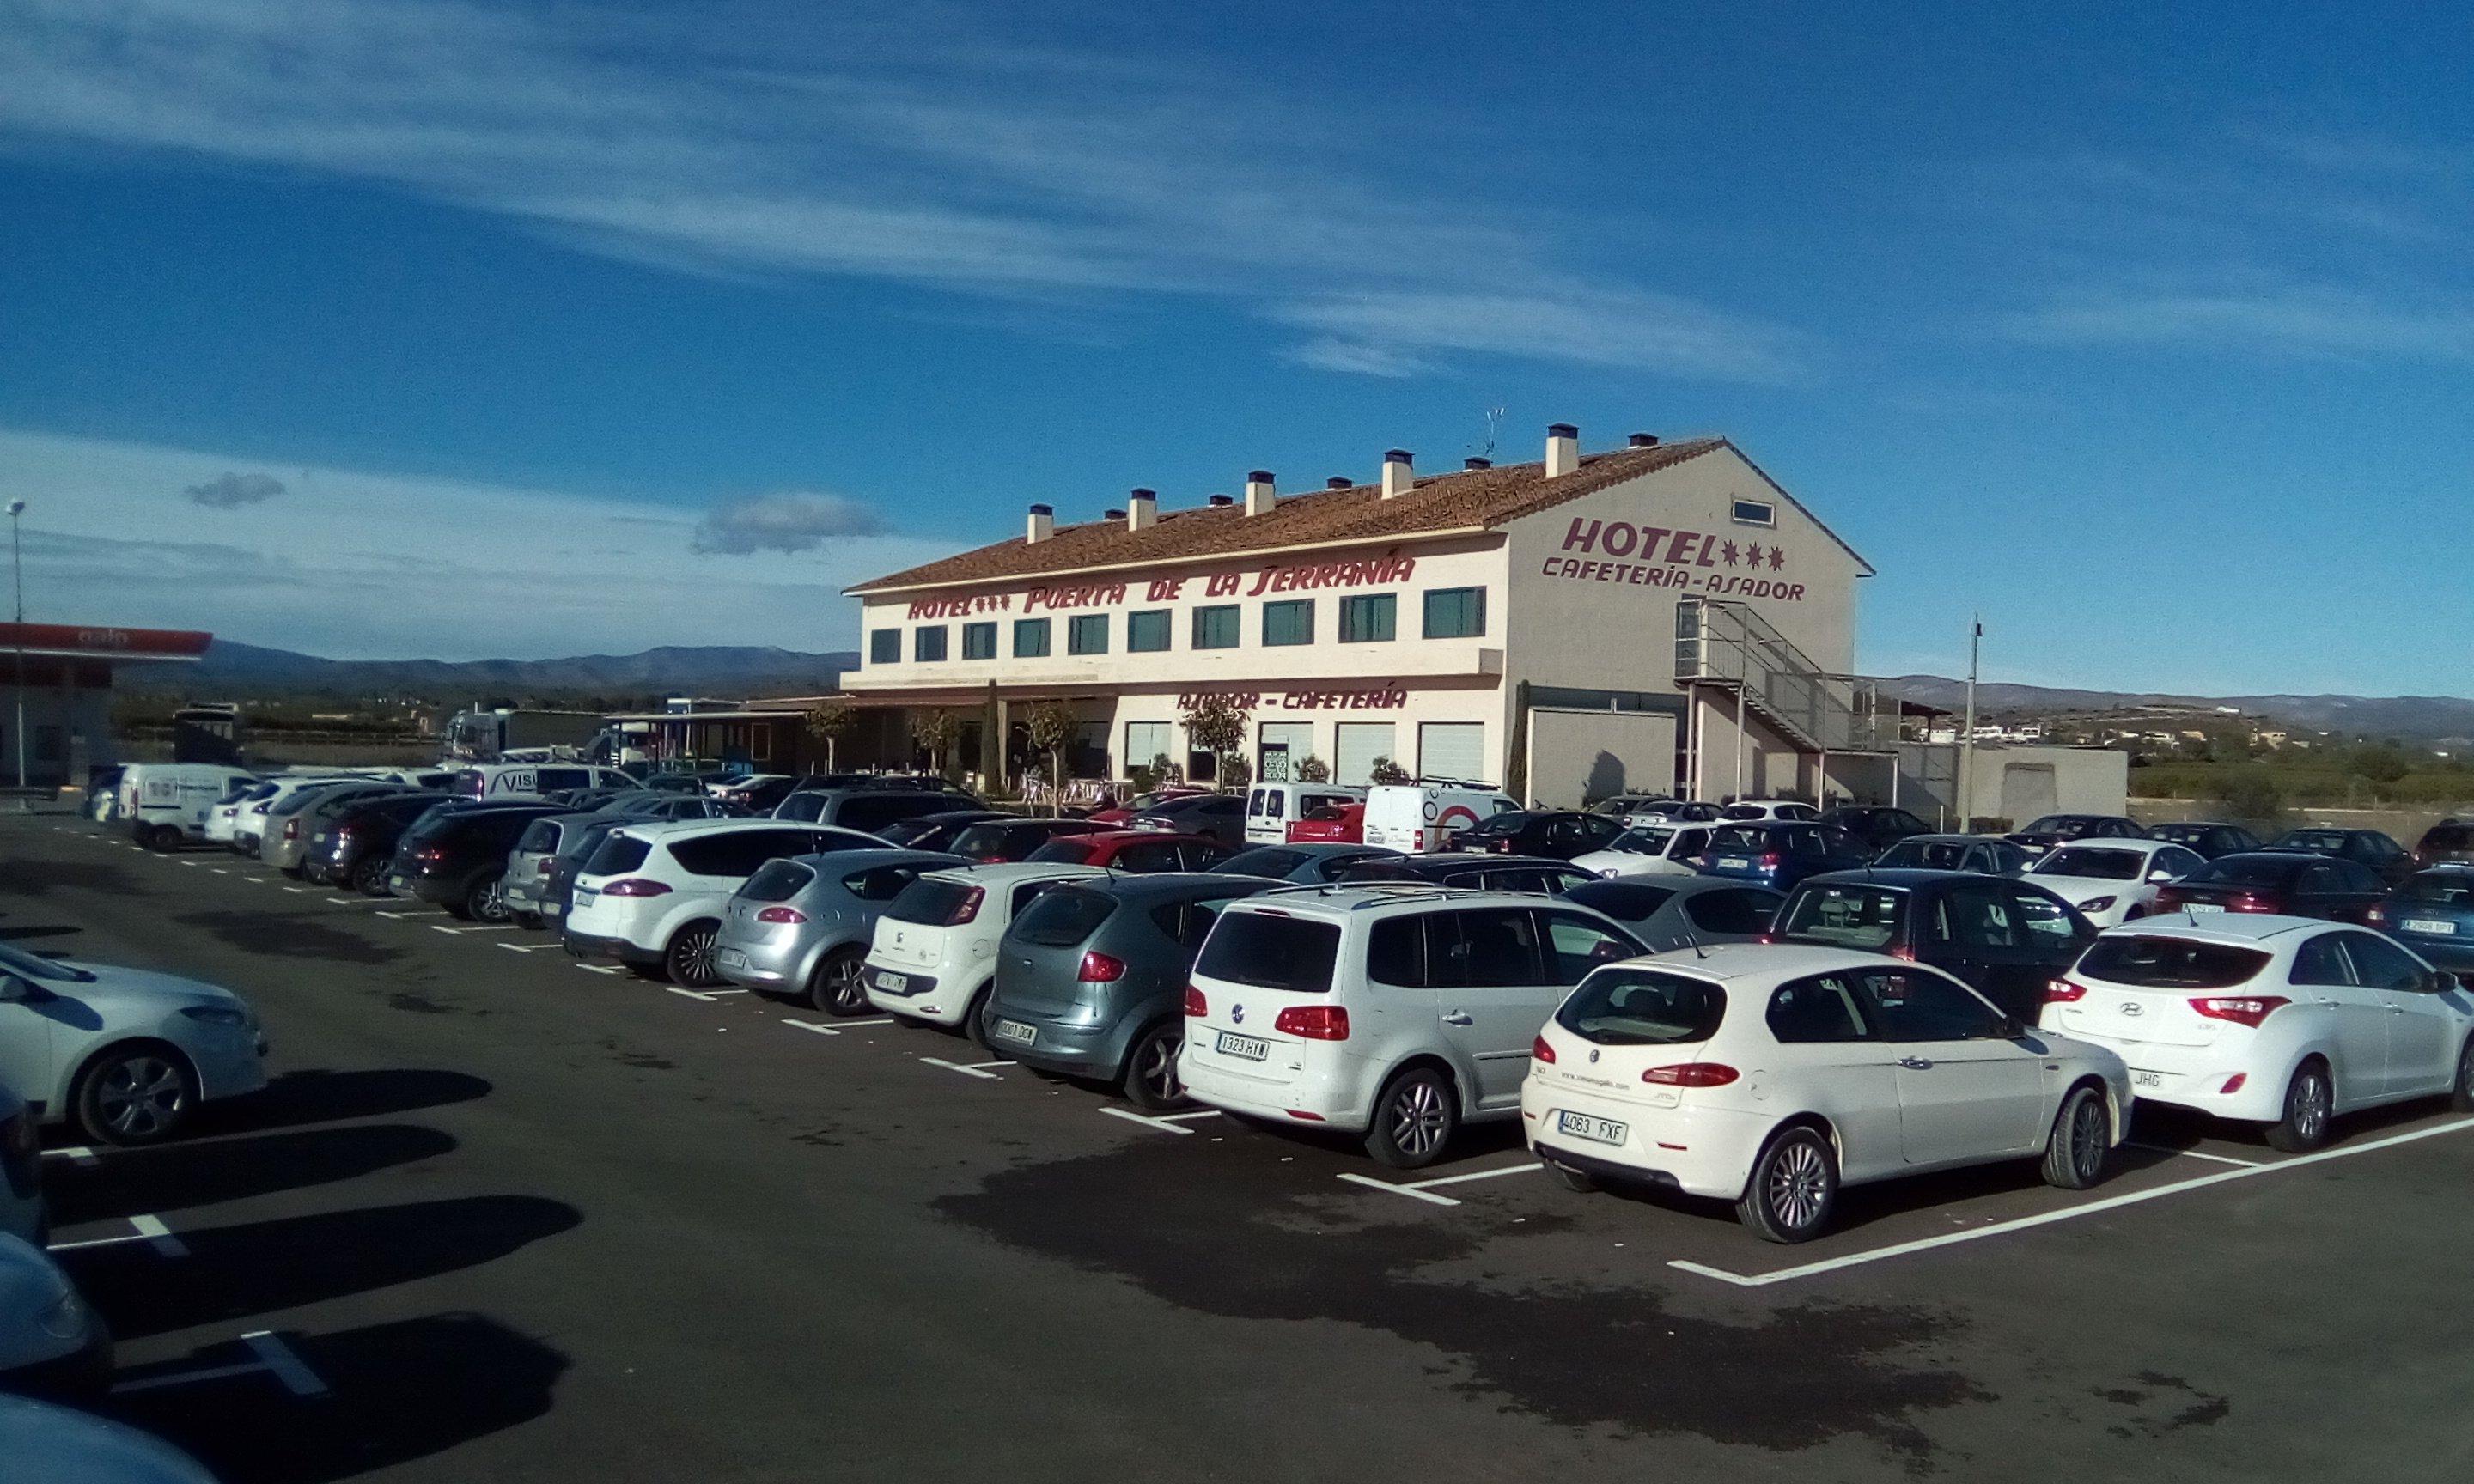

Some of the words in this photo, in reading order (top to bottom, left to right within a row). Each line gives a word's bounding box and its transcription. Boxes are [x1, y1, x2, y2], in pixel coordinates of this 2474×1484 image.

[1561, 517, 1717, 568] HOTEL
[907, 595, 975, 620] HOTEL
[1023, 583, 1127, 613] PUERTA
[1146, 576, 1189, 601] DE
[1205, 572, 1241, 597] LA
[1543, 556, 1689, 589] CAFETERÍA
[1705, 574, 1805, 601] ASADOR
[1222, 1036, 1245, 1053] 1323
[1563, 1113, 1590, 1134] 4063
[1598, 1122, 1624, 1140] FXF
